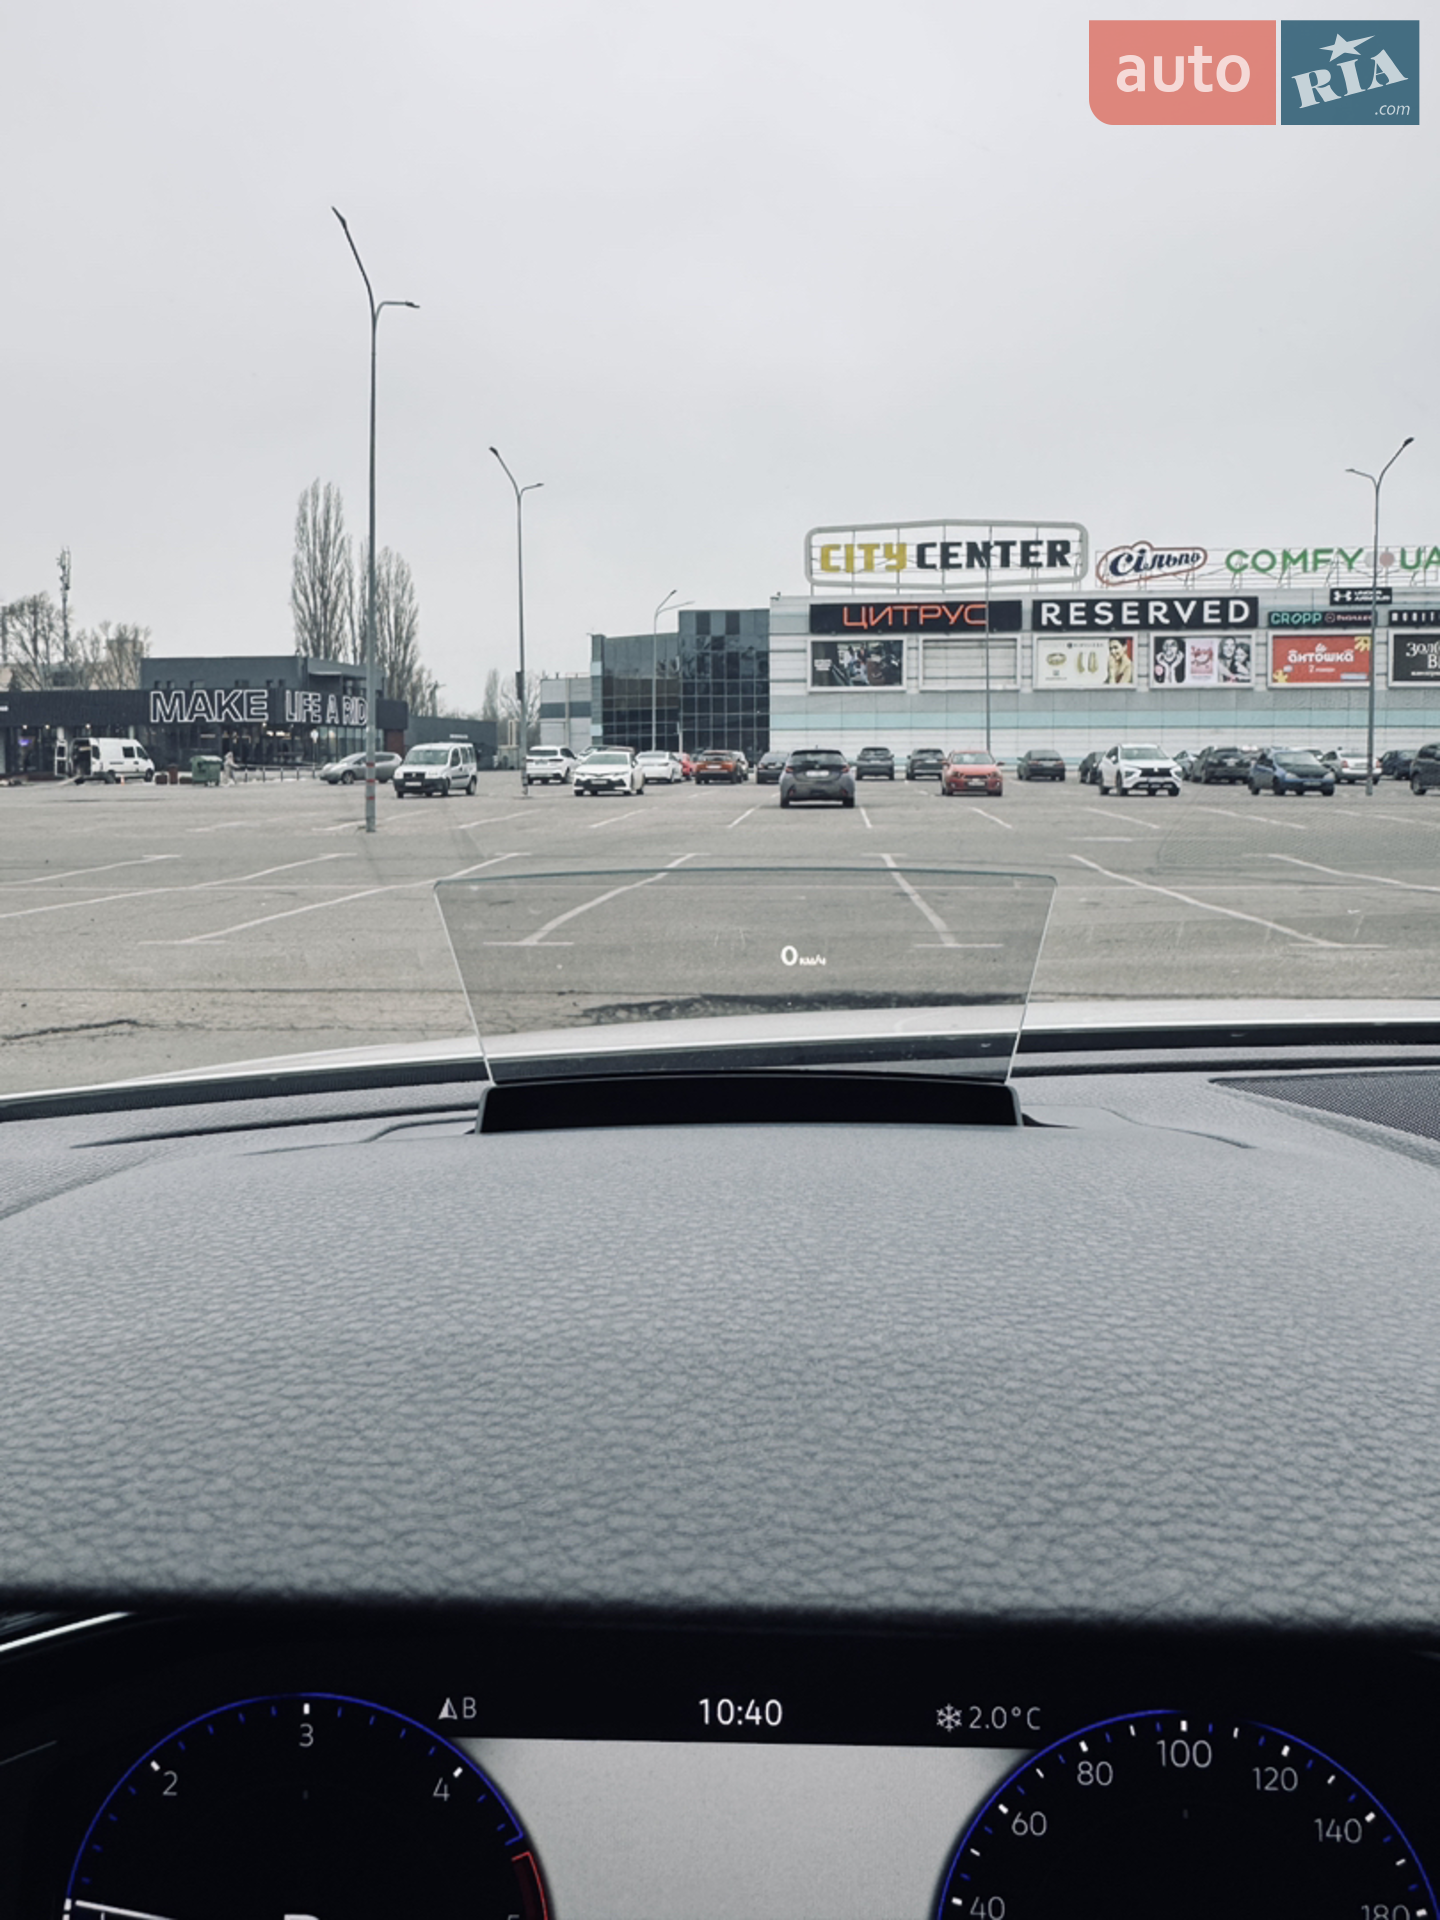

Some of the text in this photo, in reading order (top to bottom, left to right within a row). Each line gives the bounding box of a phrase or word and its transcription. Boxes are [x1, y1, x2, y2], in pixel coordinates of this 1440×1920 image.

[820, 540, 1071, 573] CITY CENTER
[1109, 548, 1201, 576] Сільпо
[1225, 548, 1364, 573] COMFY
[843, 603, 988, 629] ЦИТРУС
[1041, 600, 1250, 626] RESERVED
[1271, 612, 1322, 625] CROPP
[150, 689, 369, 726] MAKE LIFE A RID
[780, 945, 799, 967] 0
[698, 1698, 783, 1726] 10:40
[968, 1705, 1042, 1731] 2.0°C
[299, 1724, 314, 1747] 3
[1156, 1739, 1213, 1768] 100
[162, 1772, 178, 1796] 2
[1076, 1761, 1114, 1786] 80
[1252, 1766, 1299, 1792] 120
[433, 1778, 450, 1802] 4
[1011, 1811, 1048, 1837] 60
[1314, 1818, 1363, 1844] 140
[969, 1896, 1006, 1920] 40
